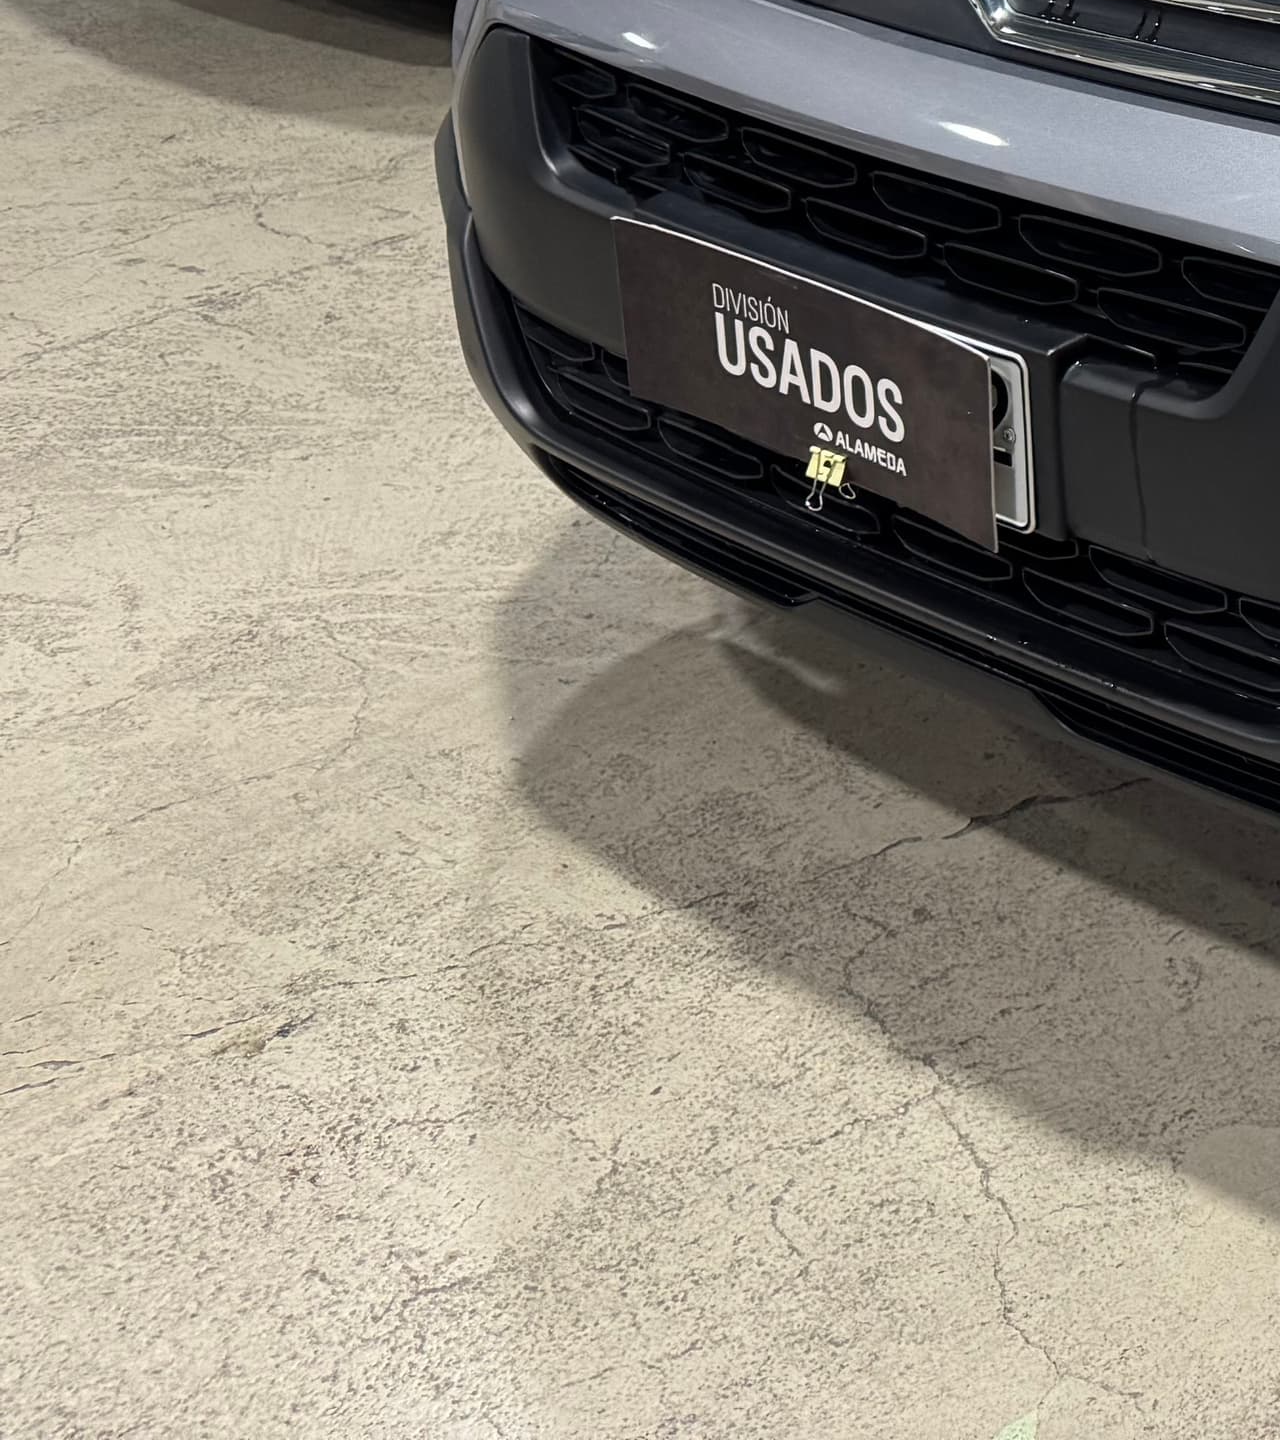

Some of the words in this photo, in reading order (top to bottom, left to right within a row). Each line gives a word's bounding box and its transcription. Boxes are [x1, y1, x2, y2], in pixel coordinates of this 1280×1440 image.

[711, 282, 790, 335] DIVISIÓN
[714, 311, 906, 443] USADOS
[835, 430, 907, 477] ALAMEDA
